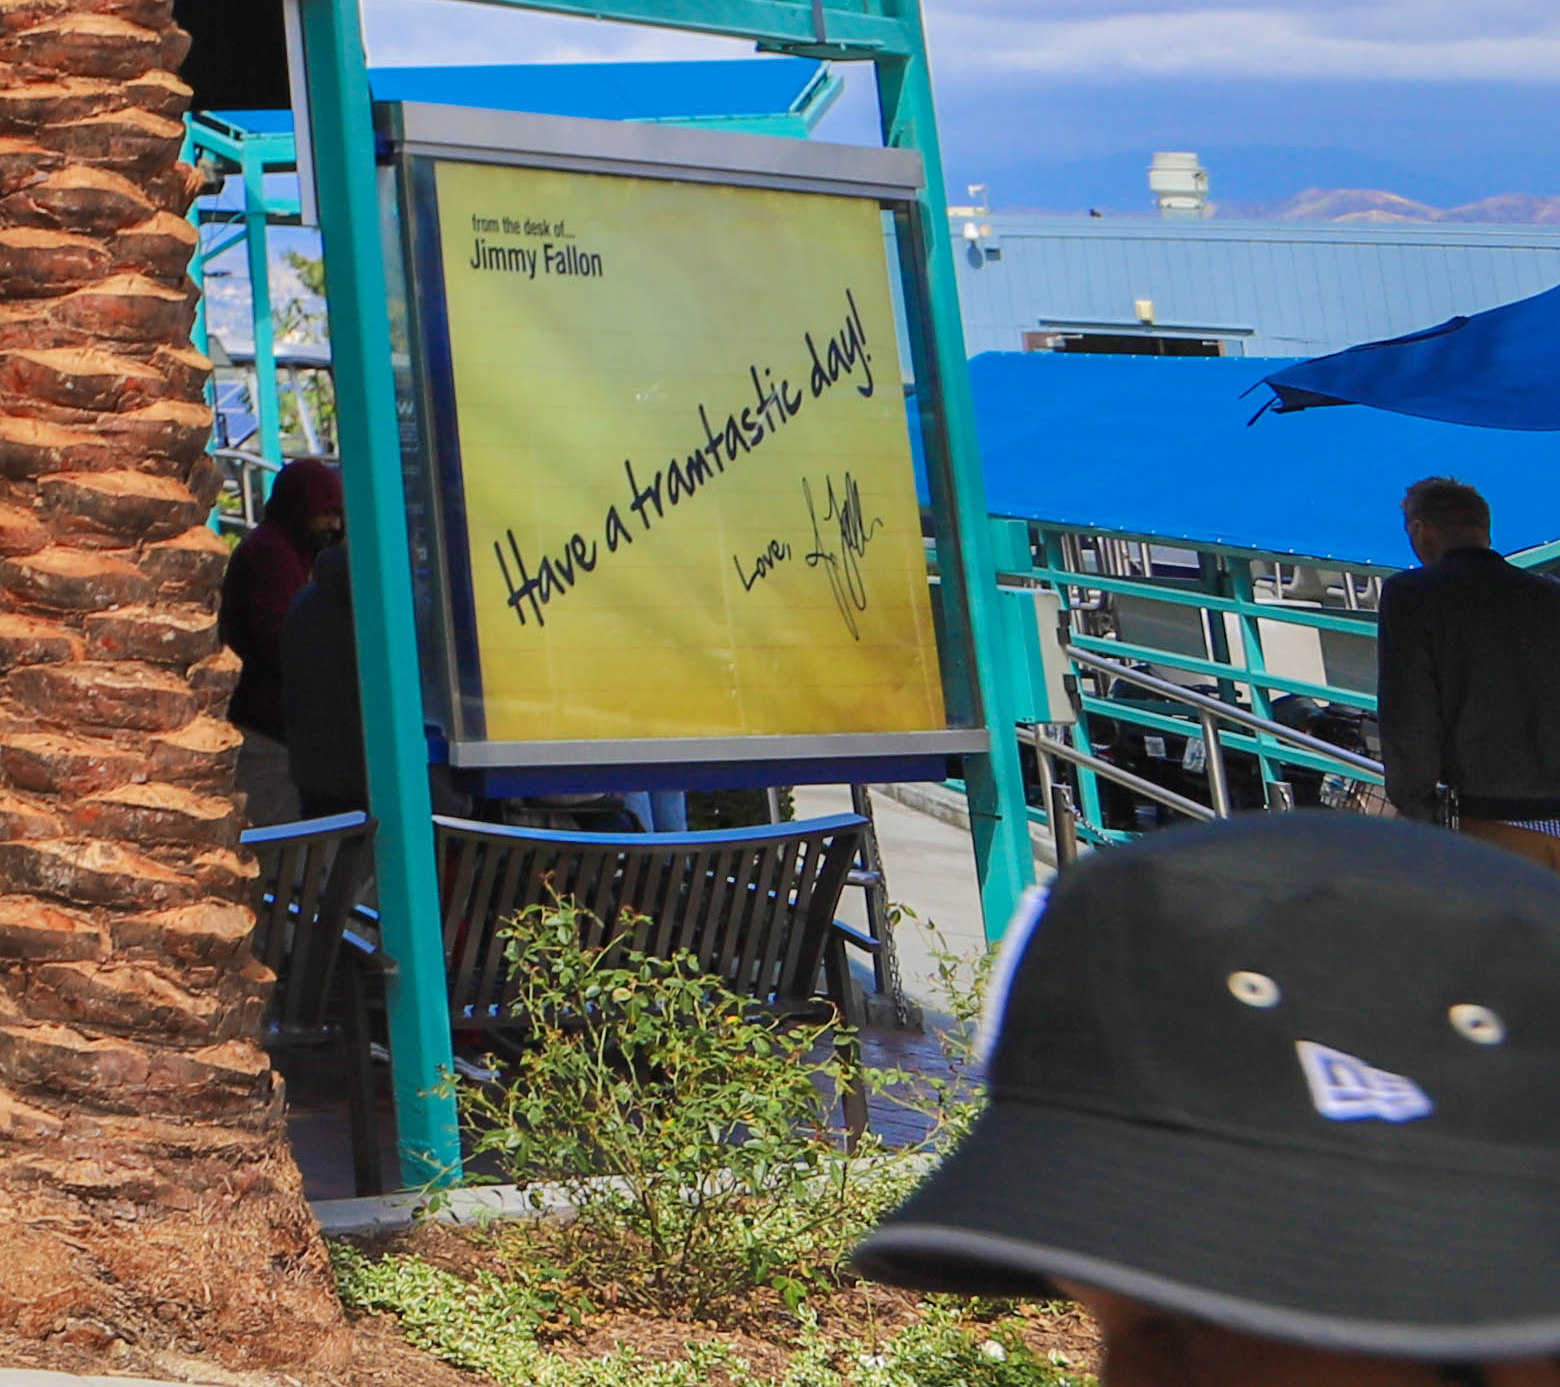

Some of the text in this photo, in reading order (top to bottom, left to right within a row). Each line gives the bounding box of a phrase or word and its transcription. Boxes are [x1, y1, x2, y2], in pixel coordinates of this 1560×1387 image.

[471, 213, 499, 233] from
[502, 215, 521, 235] the
[523, 217, 551, 237] desk
[470, 238, 603, 280] Jimmy Fallon
[494, 288, 875, 627] Have a tramtastic day!
[734, 537, 794, 594] Love,
